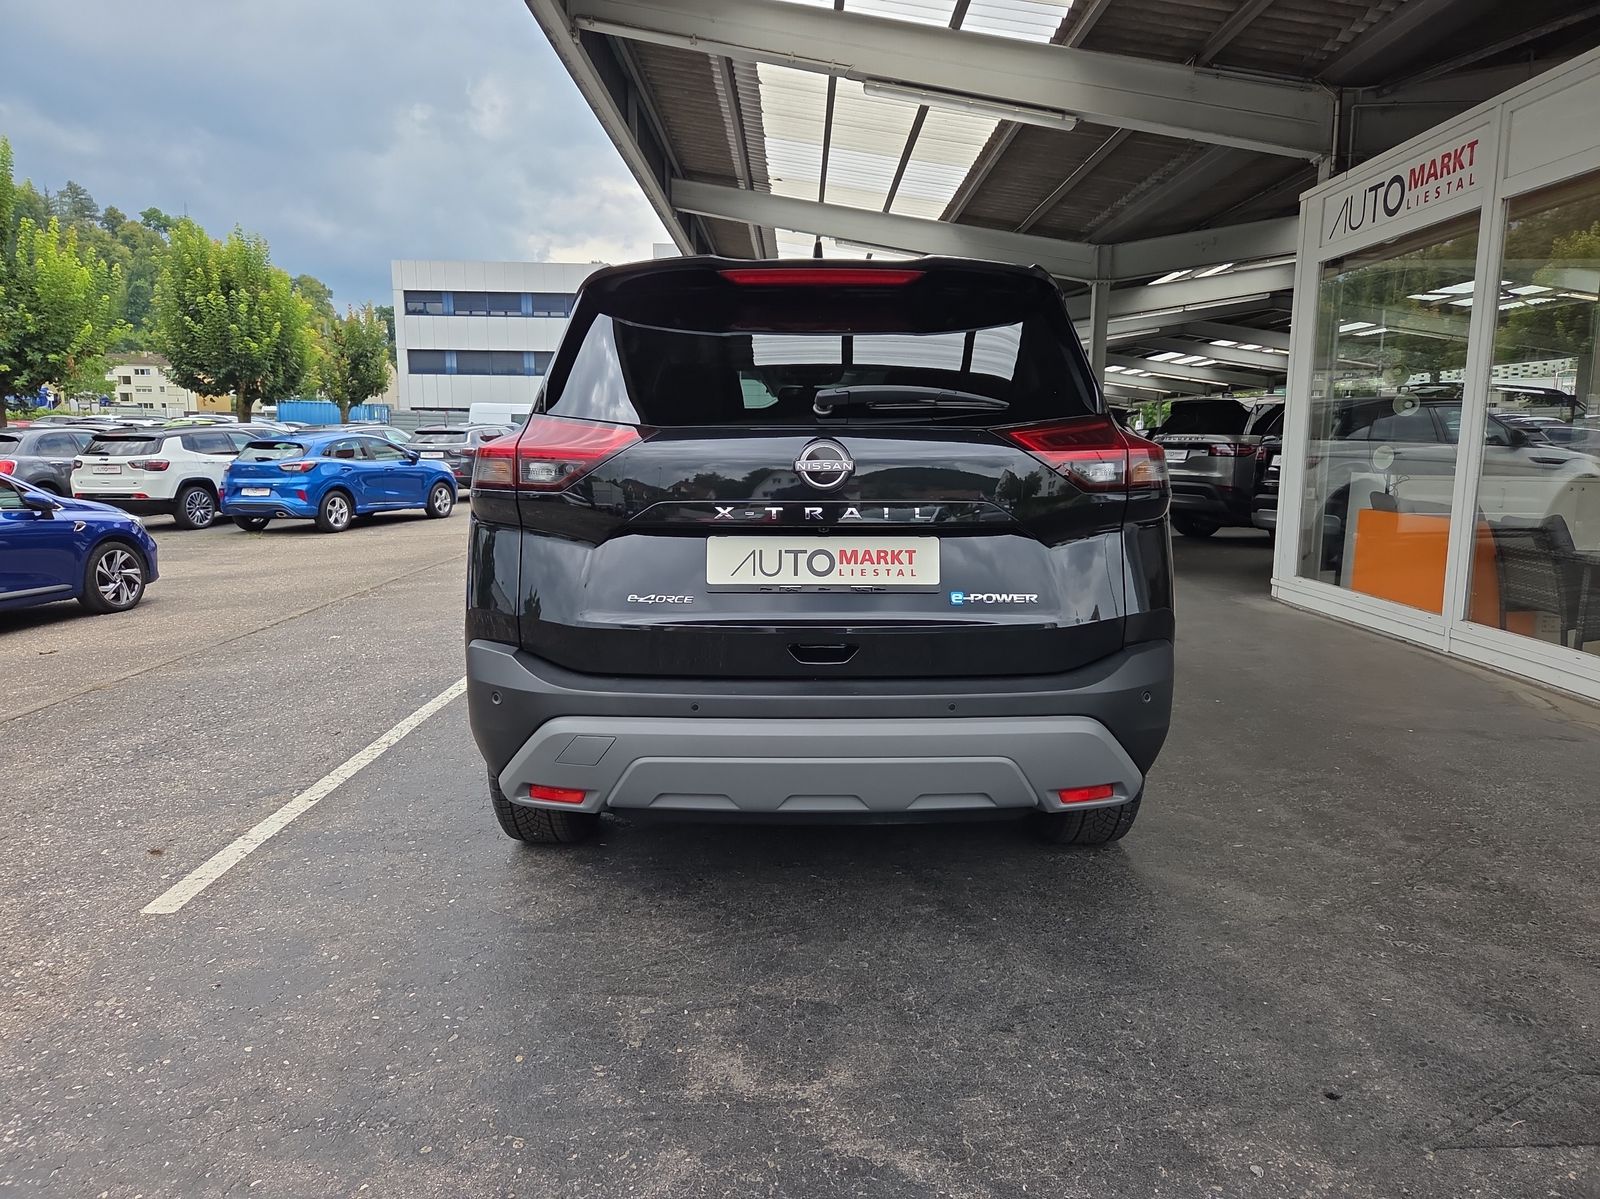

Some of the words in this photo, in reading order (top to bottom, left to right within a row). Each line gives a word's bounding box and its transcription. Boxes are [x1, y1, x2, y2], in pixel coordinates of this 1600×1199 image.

[1329, 174, 1405, 239] AUTO
[1408, 139, 1479, 191] MARKT
[1406, 173, 1475, 210] LIESTAL
[797, 462, 852, 470] NISSAN
[714, 506, 932, 520] X-TRAIL
[730, 548, 836, 577] AUTO
[838, 549, 917, 565] MARKT
[838, 568, 917, 577] LIESTAL
[950, 591, 1039, 604] e-POWER
